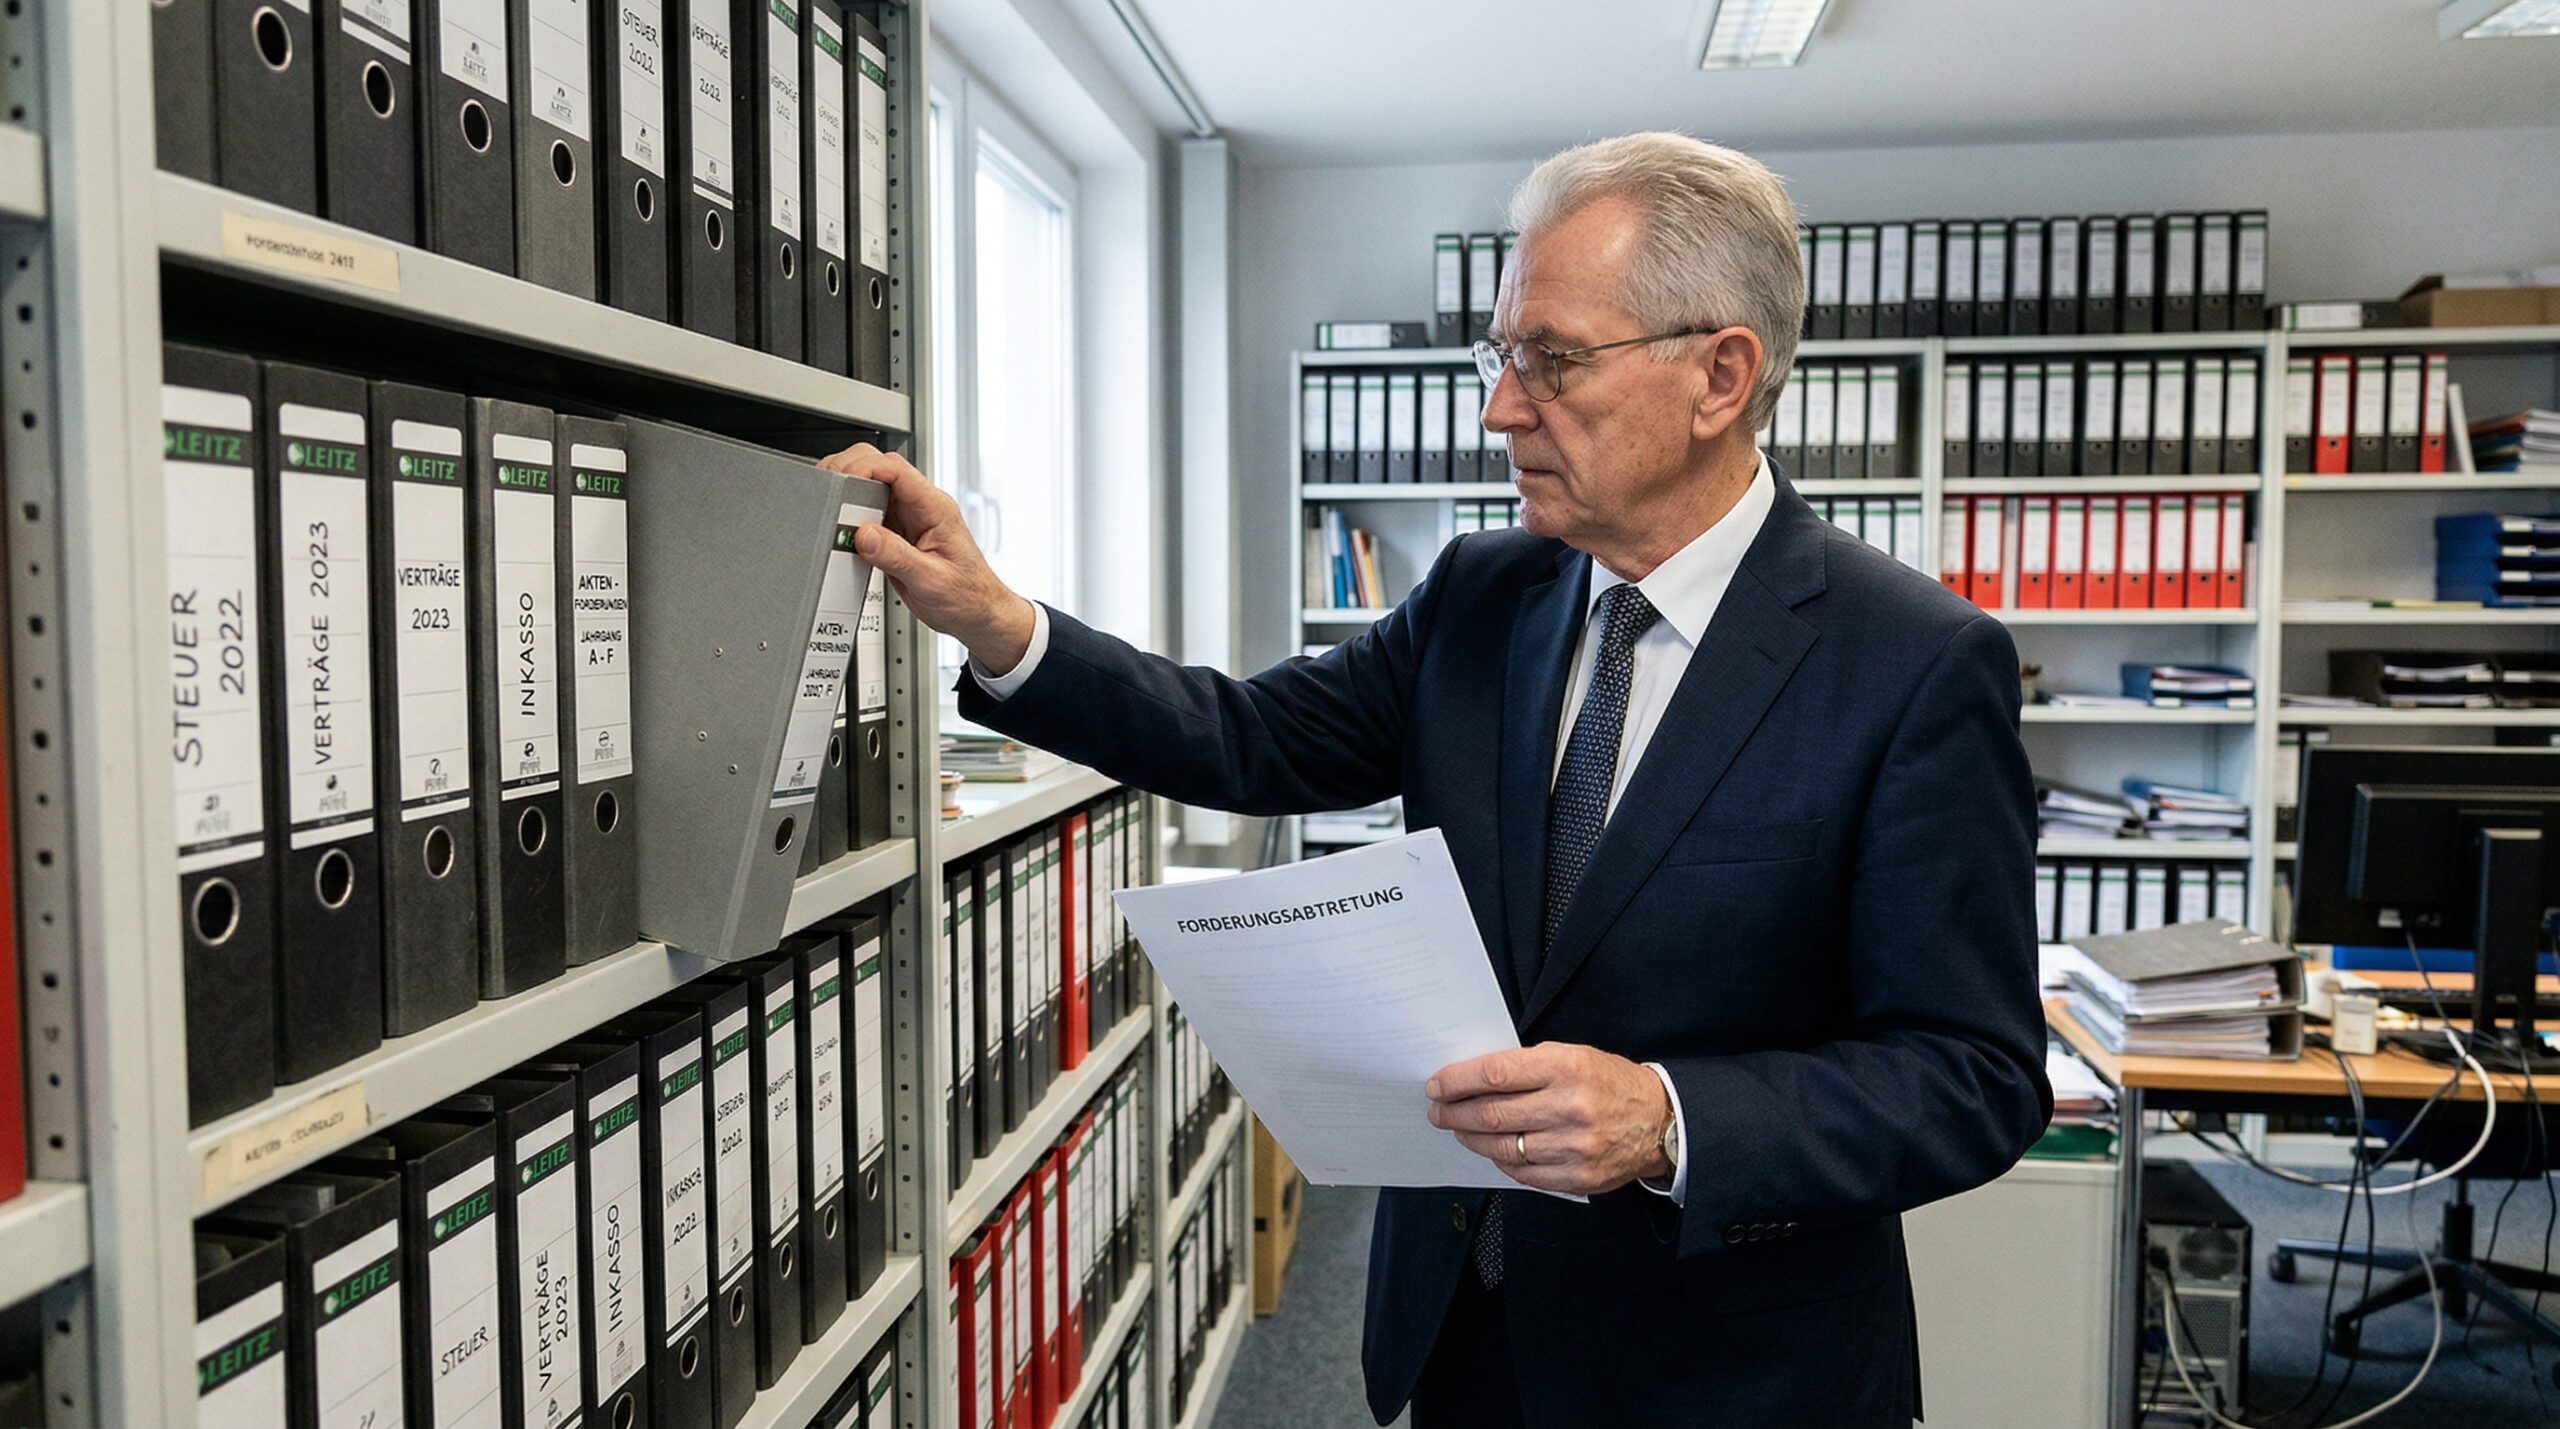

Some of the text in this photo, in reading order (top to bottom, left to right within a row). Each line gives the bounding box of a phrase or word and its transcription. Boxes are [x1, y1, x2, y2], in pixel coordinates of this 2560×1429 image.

[176, 430, 242, 461] LEITZ
[306, 445, 357, 471] LEITZ
[413, 459, 456, 480] LEITZ
[510, 468, 549, 488] LEITZ
[587, 475, 620, 494] LEITZ
[310, 521, 330, 598] 2023
[398, 563, 460, 587] VERTRÄGE
[219, 590, 246, 695] 2022
[412, 607, 450, 630] 2023
[171, 588, 203, 766] STEUER
[520, 592, 536, 717] INKASSO
[307, 616, 333, 765] VERTRÄGE
[1177, 886, 1404, 934] FORDERUNGSABTRETUNG
[672, 1064, 699, 1094] LEITZ
[603, 1102, 634, 1136] LEITZ
[533, 1141, 569, 1179] LEITZ
[447, 1191, 489, 1234] LEITZ
[340, 1261, 391, 1309] LEITZ
[607, 1204, 623, 1333] INKASSO
[534, 1250, 553, 1392] VERTRÄGE
[555, 1275, 569, 1342] 2023
[208, 1329, 272, 1386] LEITZ
[441, 1326, 489, 1375] STEUER
